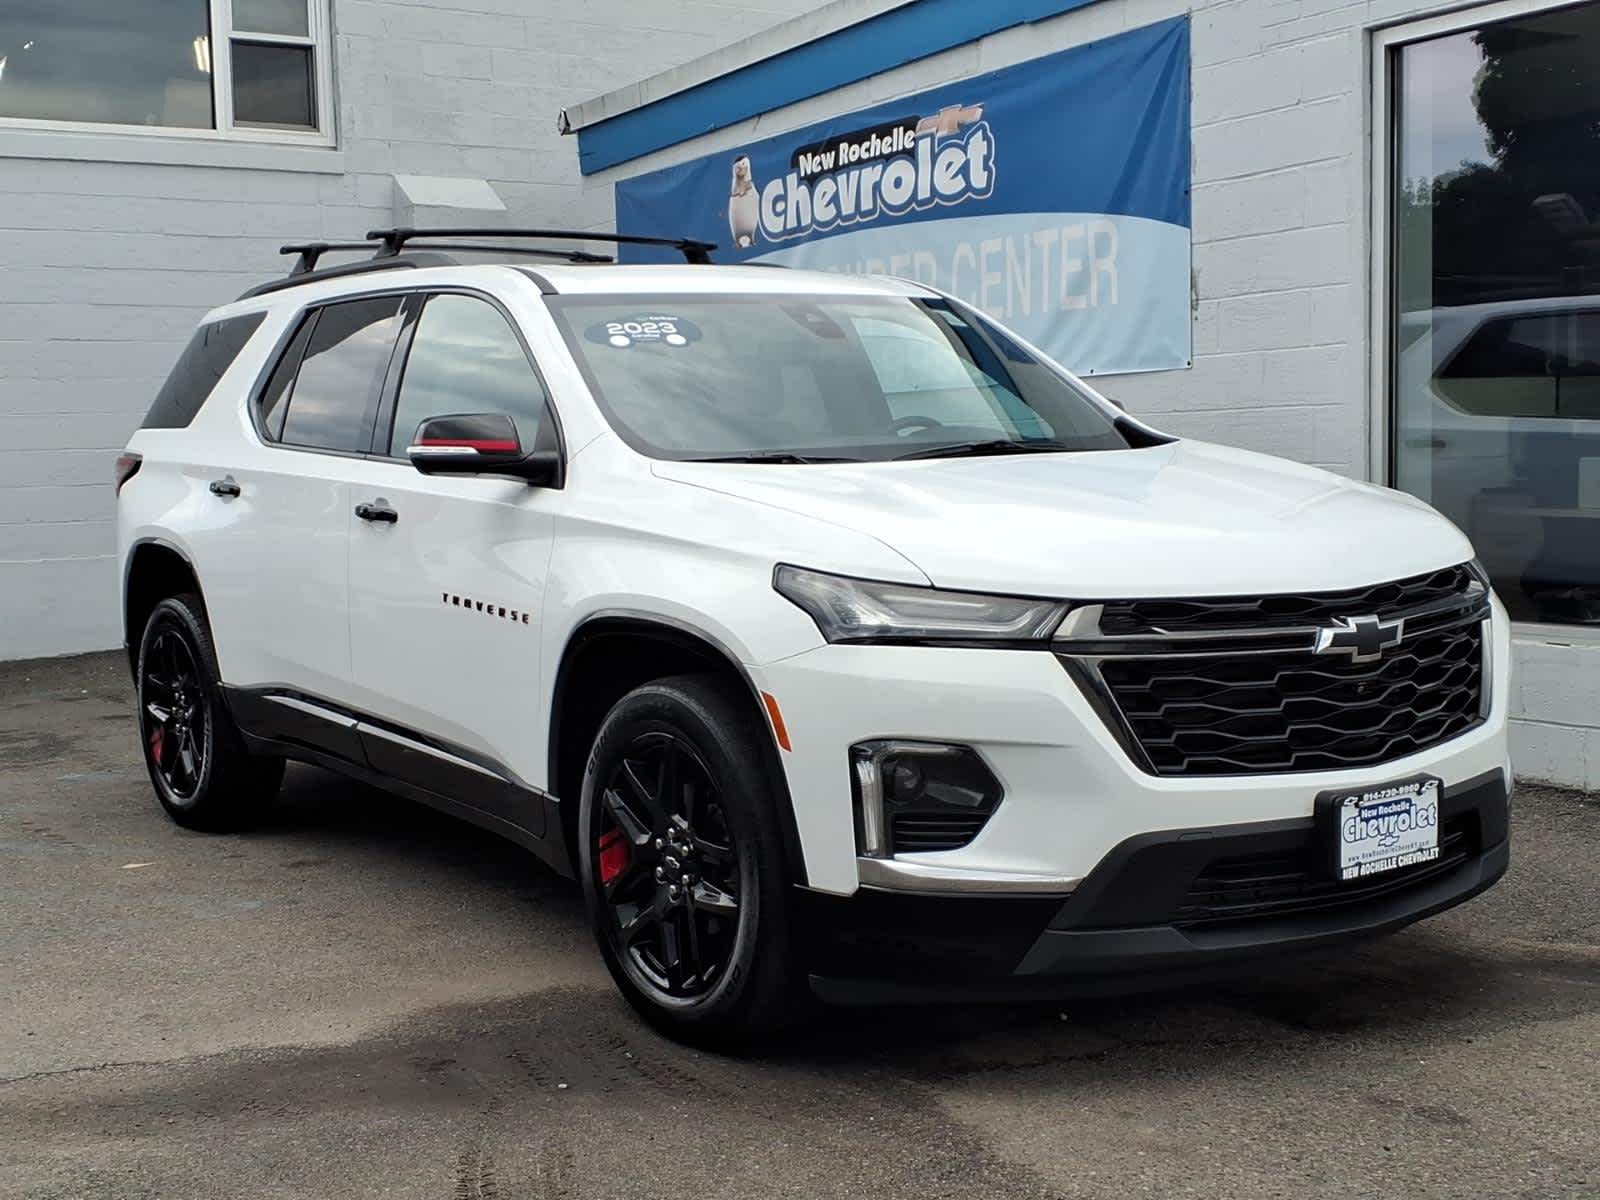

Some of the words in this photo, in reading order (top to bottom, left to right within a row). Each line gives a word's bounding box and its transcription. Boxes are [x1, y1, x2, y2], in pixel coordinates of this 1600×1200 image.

[799, 149, 836, 177] New
[839, 126, 915, 165] Rochelle
[761, 128, 988, 233] Chevrolet
[952, 219, 1119, 319] CENTER
[606, 321, 678, 335] 2023
[442, 592, 529, 624] TRAVERSE
[1343, 803, 1437, 843] Chevrolet
[1361, 808, 1377, 819] New
[1378, 800, 1410, 815] Rochelle
[1342, 865, 1359, 880] NEW
[1360, 856, 1397, 876] ROCHELLE
[1398, 847, 1440, 868] CHEVROLET
